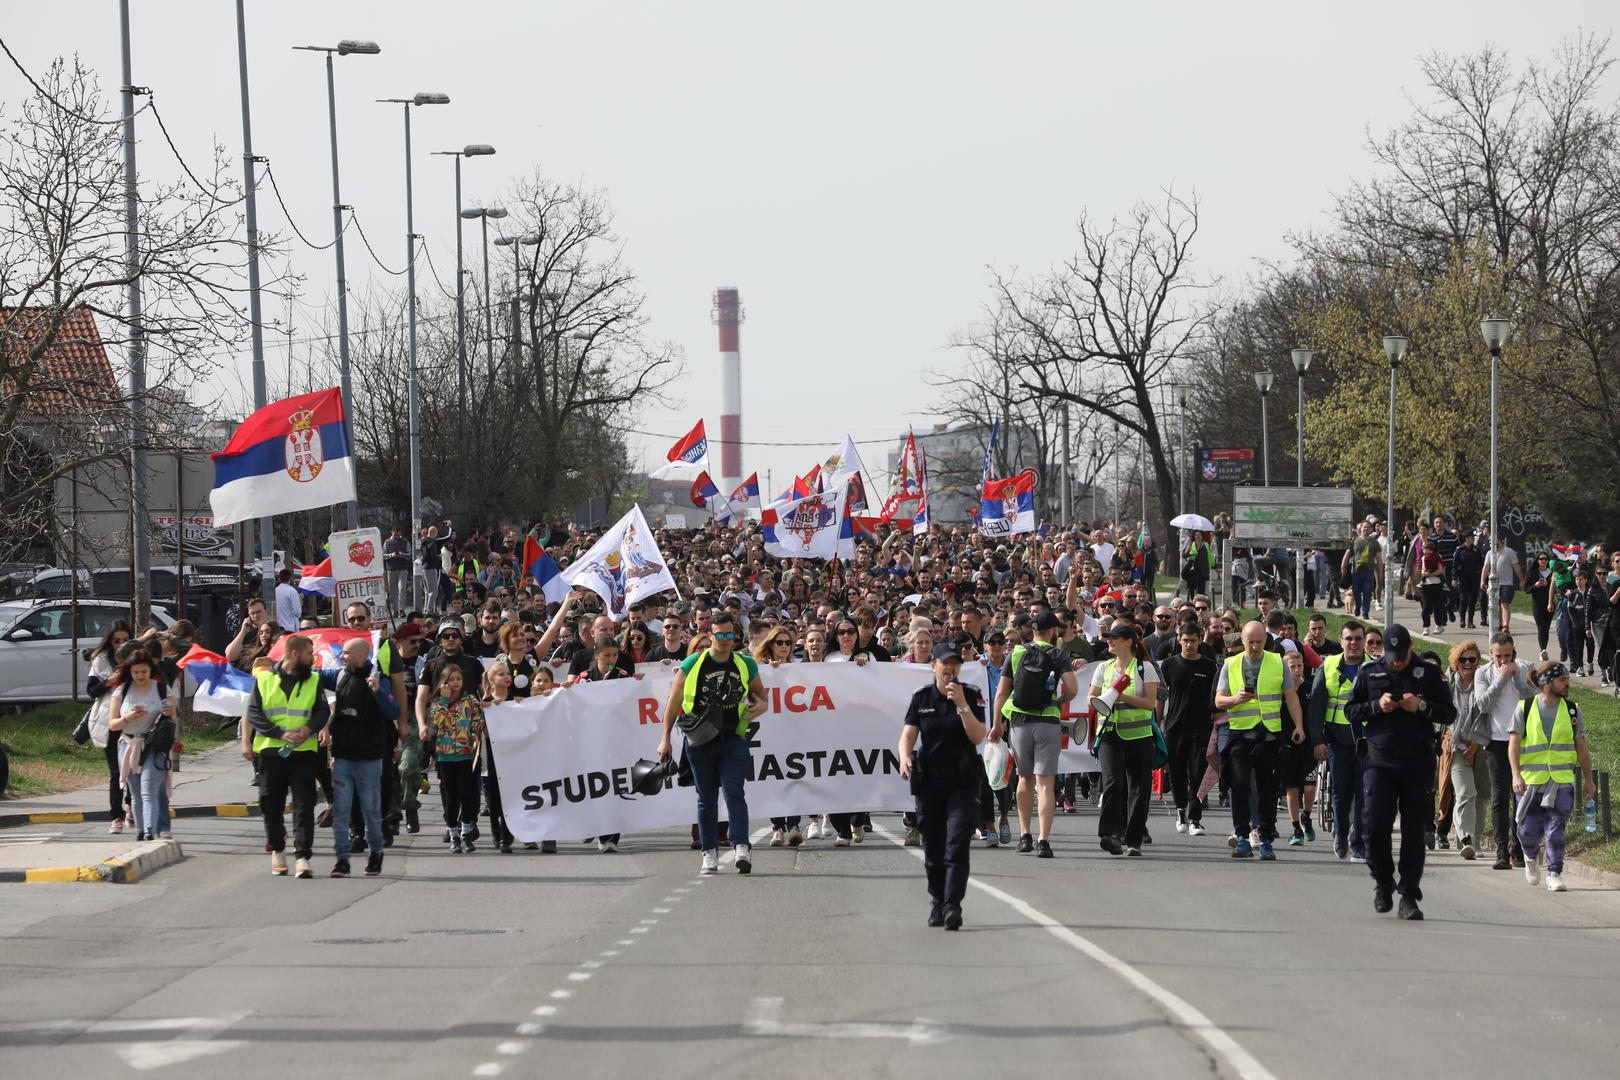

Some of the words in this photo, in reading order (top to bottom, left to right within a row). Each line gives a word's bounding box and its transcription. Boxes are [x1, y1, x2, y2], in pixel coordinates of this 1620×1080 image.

[638, 685, 836, 726] RICA
[521, 767, 674, 811] STUDE
[745, 748, 904, 782] ASTAVN
